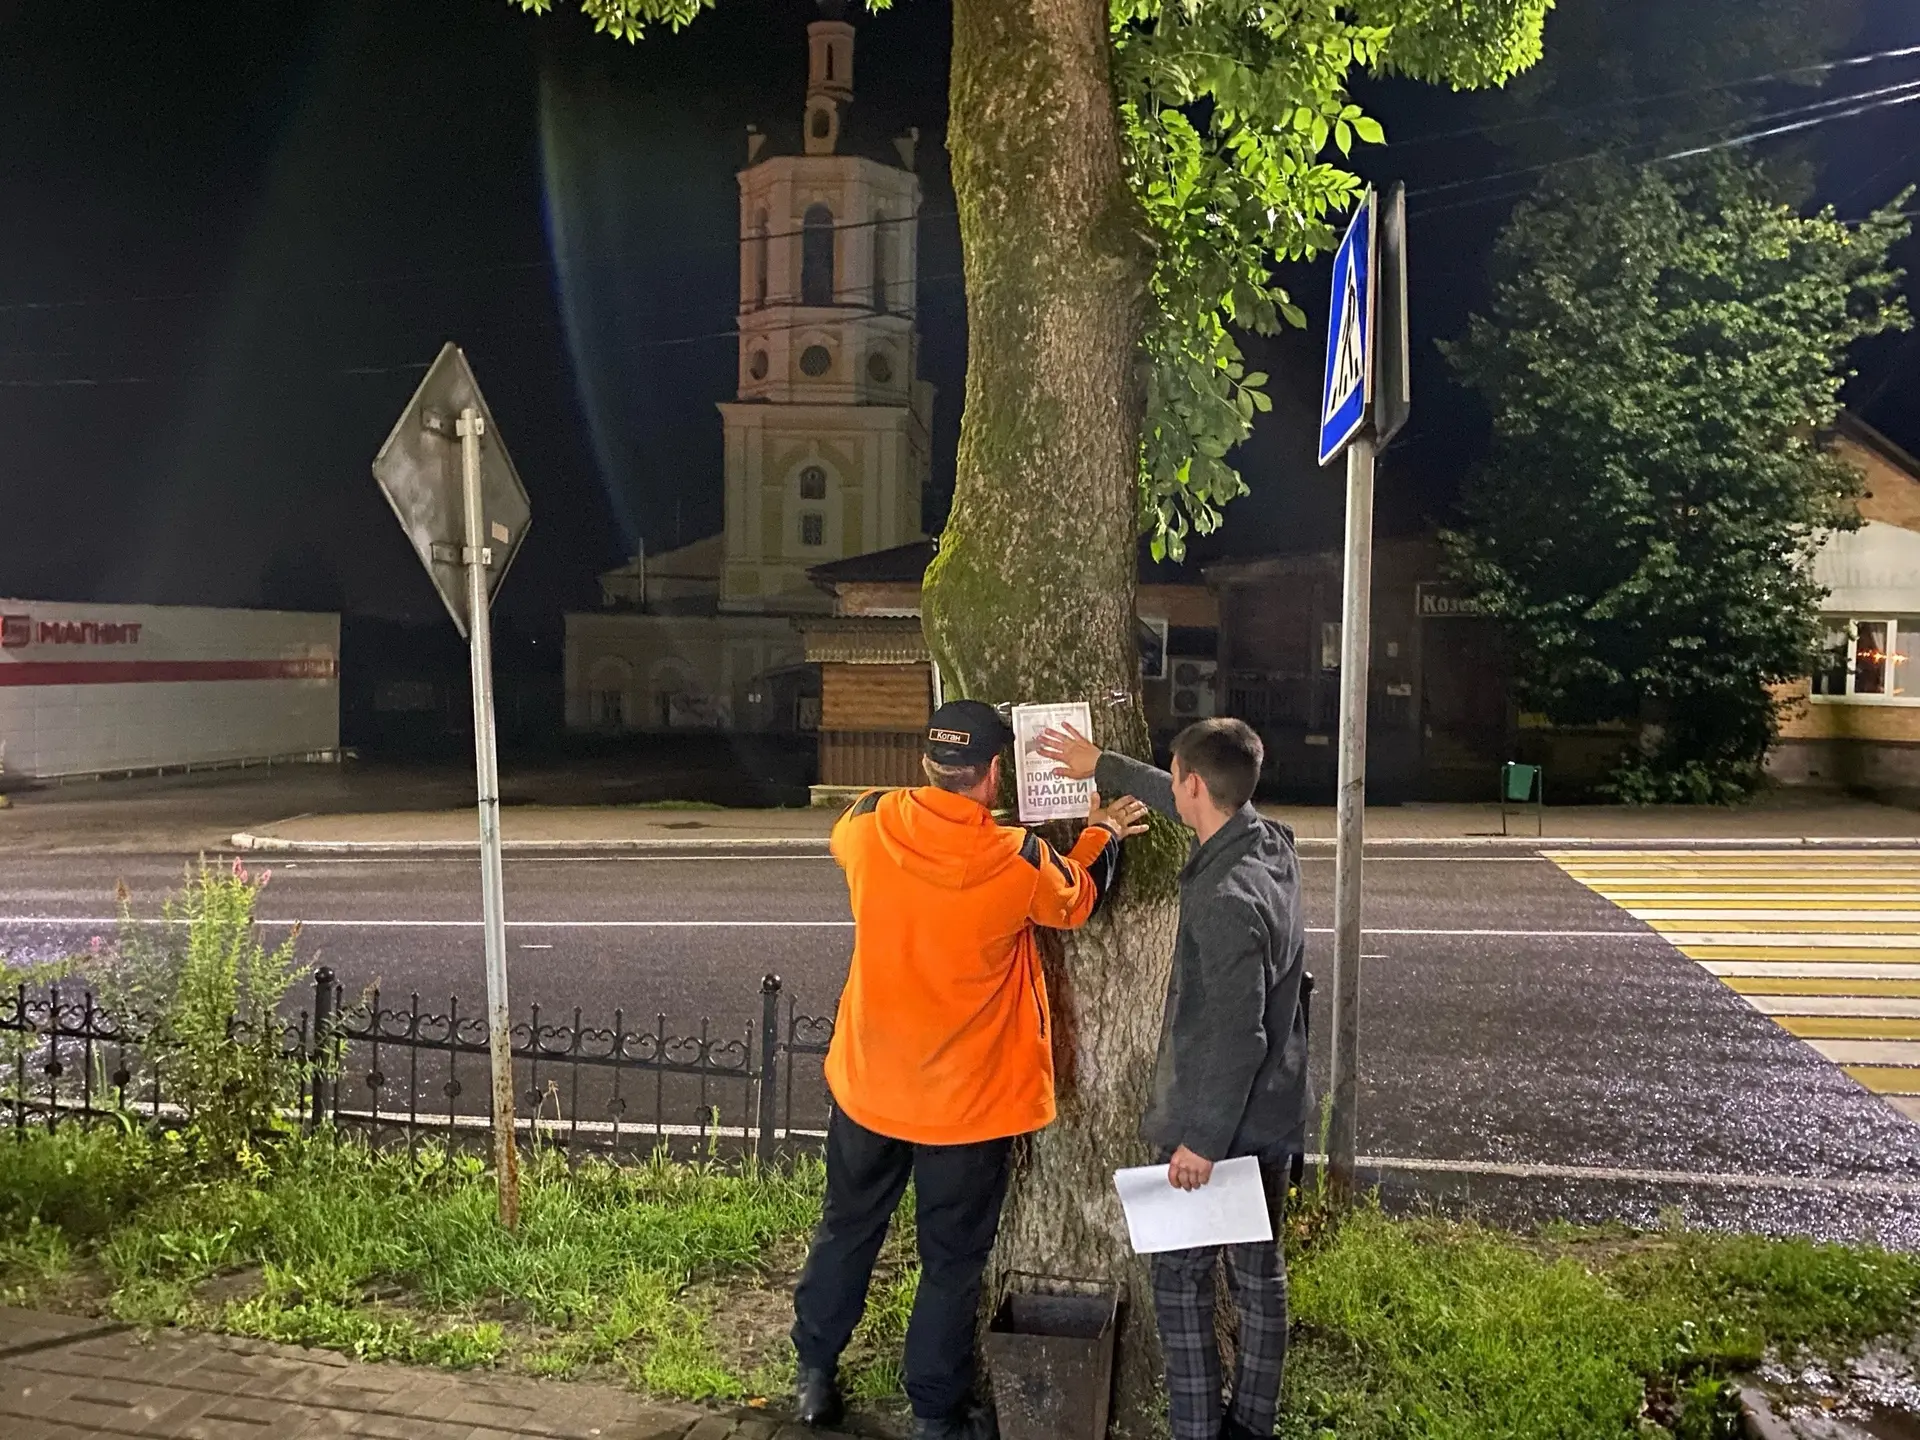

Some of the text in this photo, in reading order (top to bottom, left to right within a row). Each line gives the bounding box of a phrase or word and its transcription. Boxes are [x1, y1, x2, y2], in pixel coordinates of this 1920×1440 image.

[37, 621, 142, 644] МАГНИТ
[937, 731, 961, 742] Коган
[1027, 780, 1088, 796] НАЙТИ
[1028, 795, 1089, 807] ЧЕЛОВЕКА
